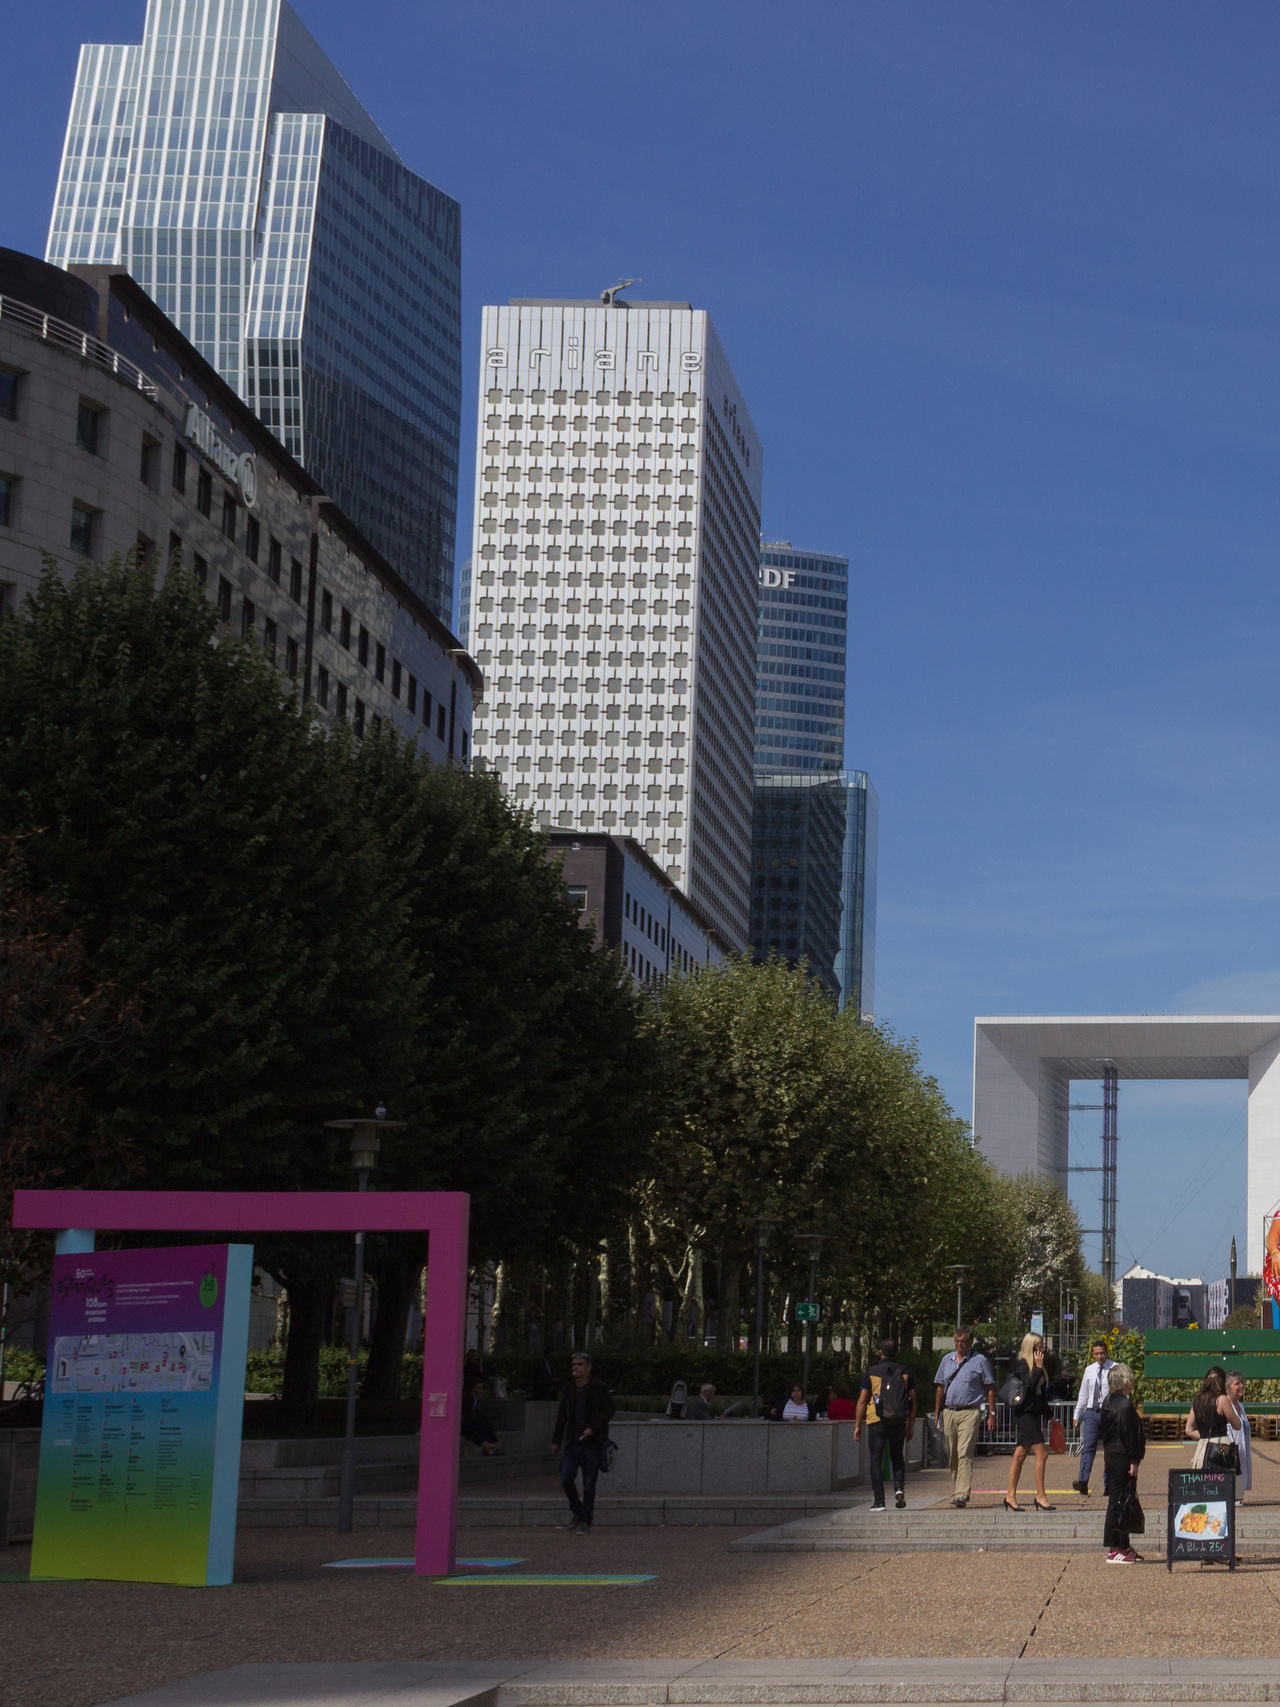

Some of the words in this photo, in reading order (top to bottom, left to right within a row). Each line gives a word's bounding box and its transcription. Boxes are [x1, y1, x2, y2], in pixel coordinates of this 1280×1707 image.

[486, 335, 702, 372] ariane
[184, 400, 239, 485] Allianz
[723, 393, 750, 468] ariane
[1203, 1483, 1219, 1496] Food
[1176, 1543, 1185, 1553] A
